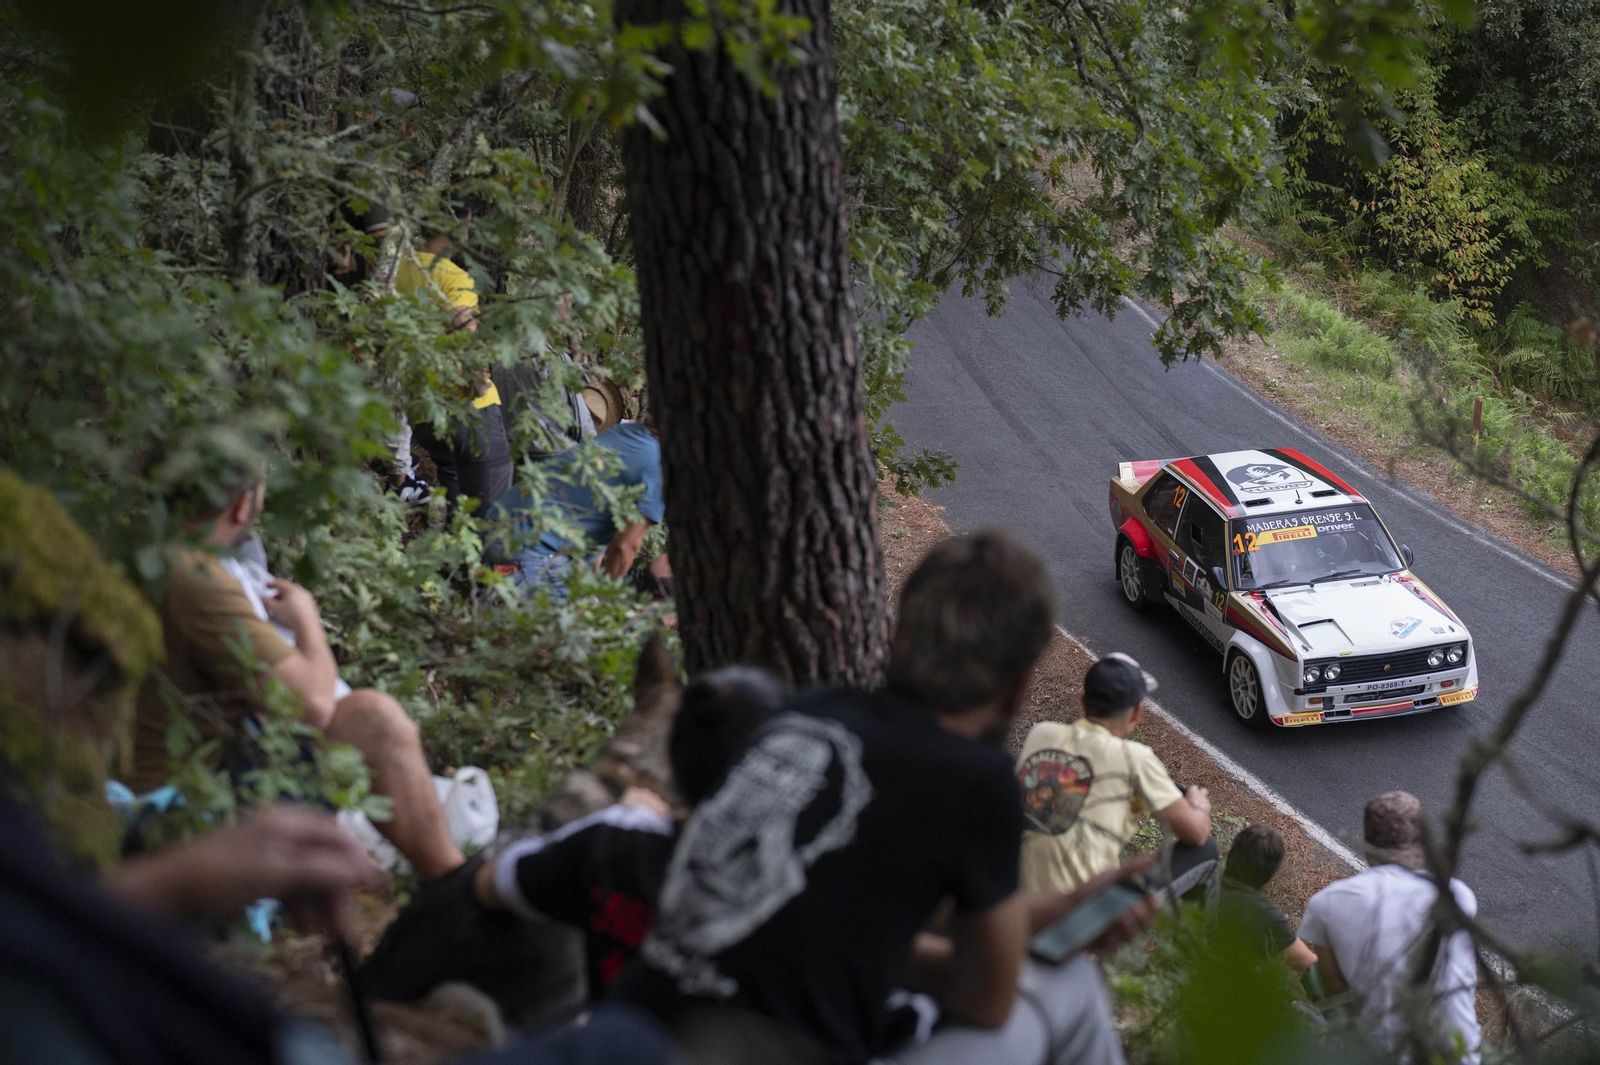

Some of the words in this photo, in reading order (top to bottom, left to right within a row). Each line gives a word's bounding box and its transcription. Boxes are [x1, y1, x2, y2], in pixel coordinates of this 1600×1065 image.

[1173, 485, 1186, 508] 12
[1246, 518, 1298, 532] MADERAS
[1272, 528, 1312, 541] PIRELLI
[1233, 532, 1260, 554] 12
[1215, 591, 1225, 610] 12
[1367, 681, 1405, 690] PO-8368-T
[1443, 692, 1472, 703] PIRELLI
[1284, 713, 1320, 724] PIRELLI
